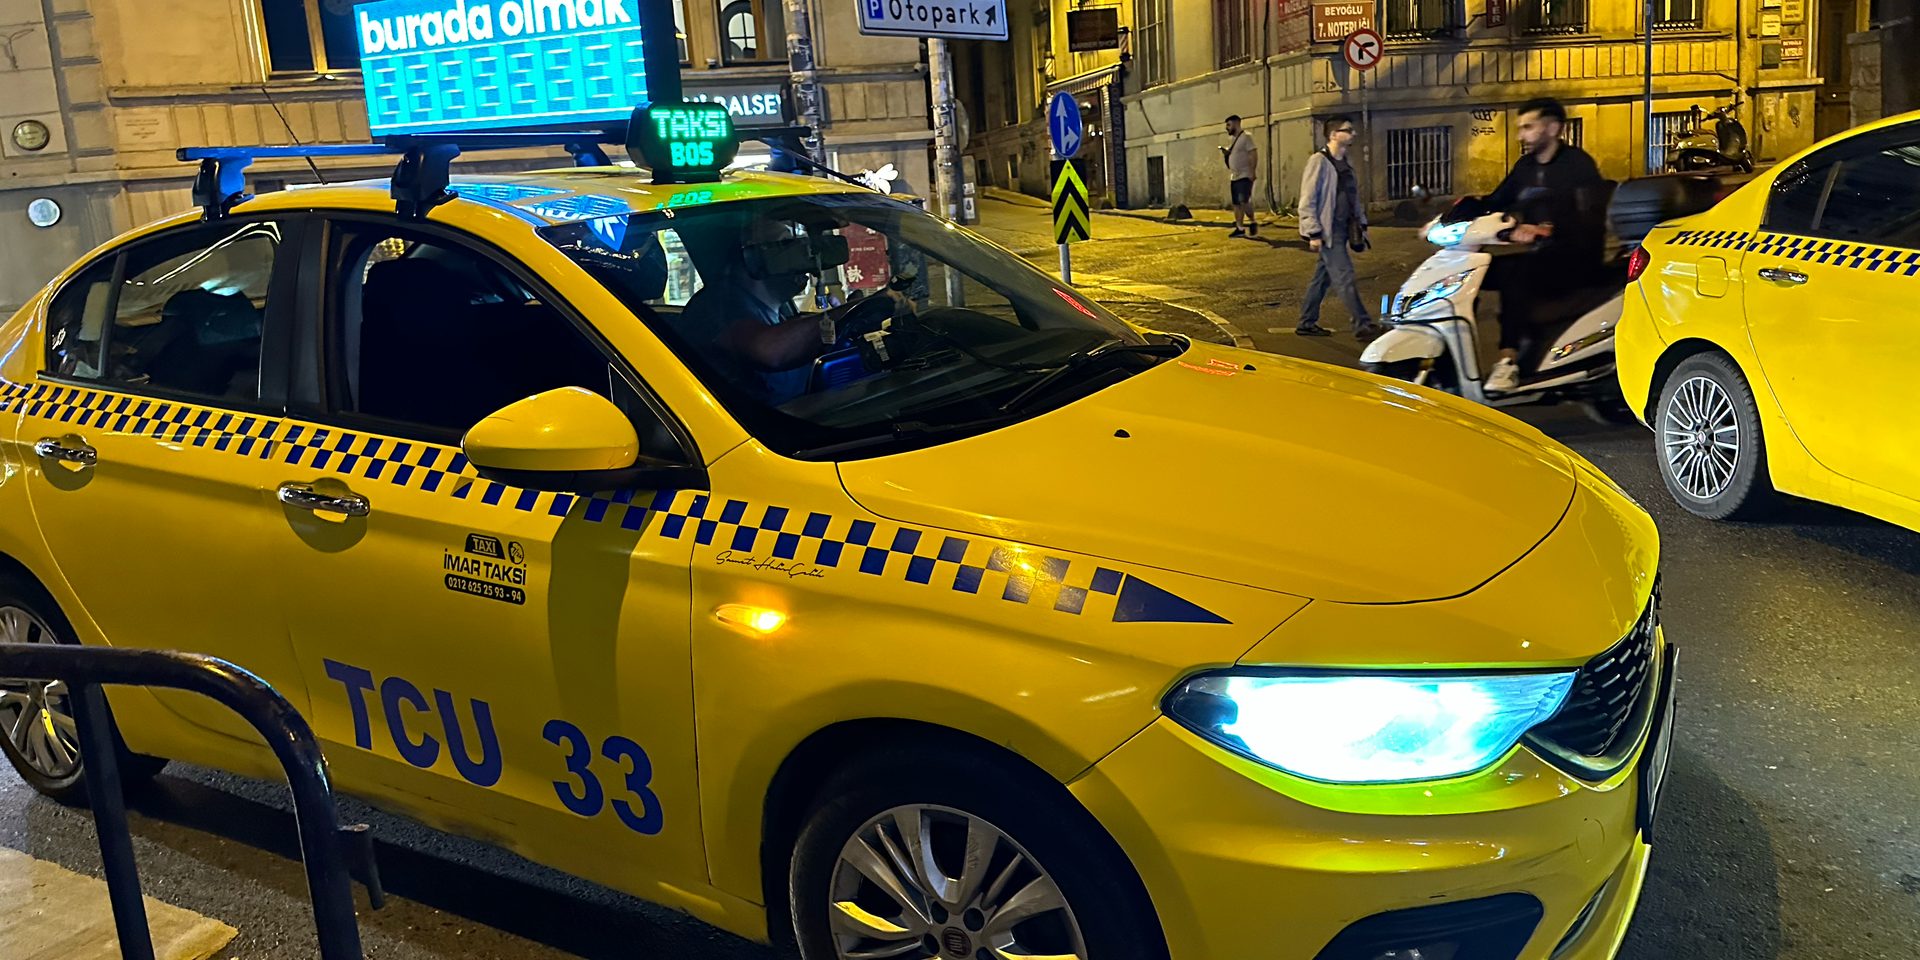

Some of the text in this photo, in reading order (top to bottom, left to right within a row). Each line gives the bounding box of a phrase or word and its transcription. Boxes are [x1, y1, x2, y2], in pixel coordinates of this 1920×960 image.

[889, 0, 981, 29] Otopark
[1324, 4, 1363, 16] BEYOĞLU
[360, 0, 632, 54] burada olmak
[1318, 22, 1327, 38] 7.
[713, 94, 781, 116] ALSE
[670, 142, 714, 167] BOS
[472, 538, 496, 554] TAXI
[443, 548, 527, 586] İMAR TAKSİ
[448, 576, 467, 591] 0212
[467, 581, 482, 594] 625
[483, 584, 493, 596] 25
[494, 586, 505, 599] 93
[511, 590, 522, 603] 94
[322, 657, 664, 836] TCU 33
